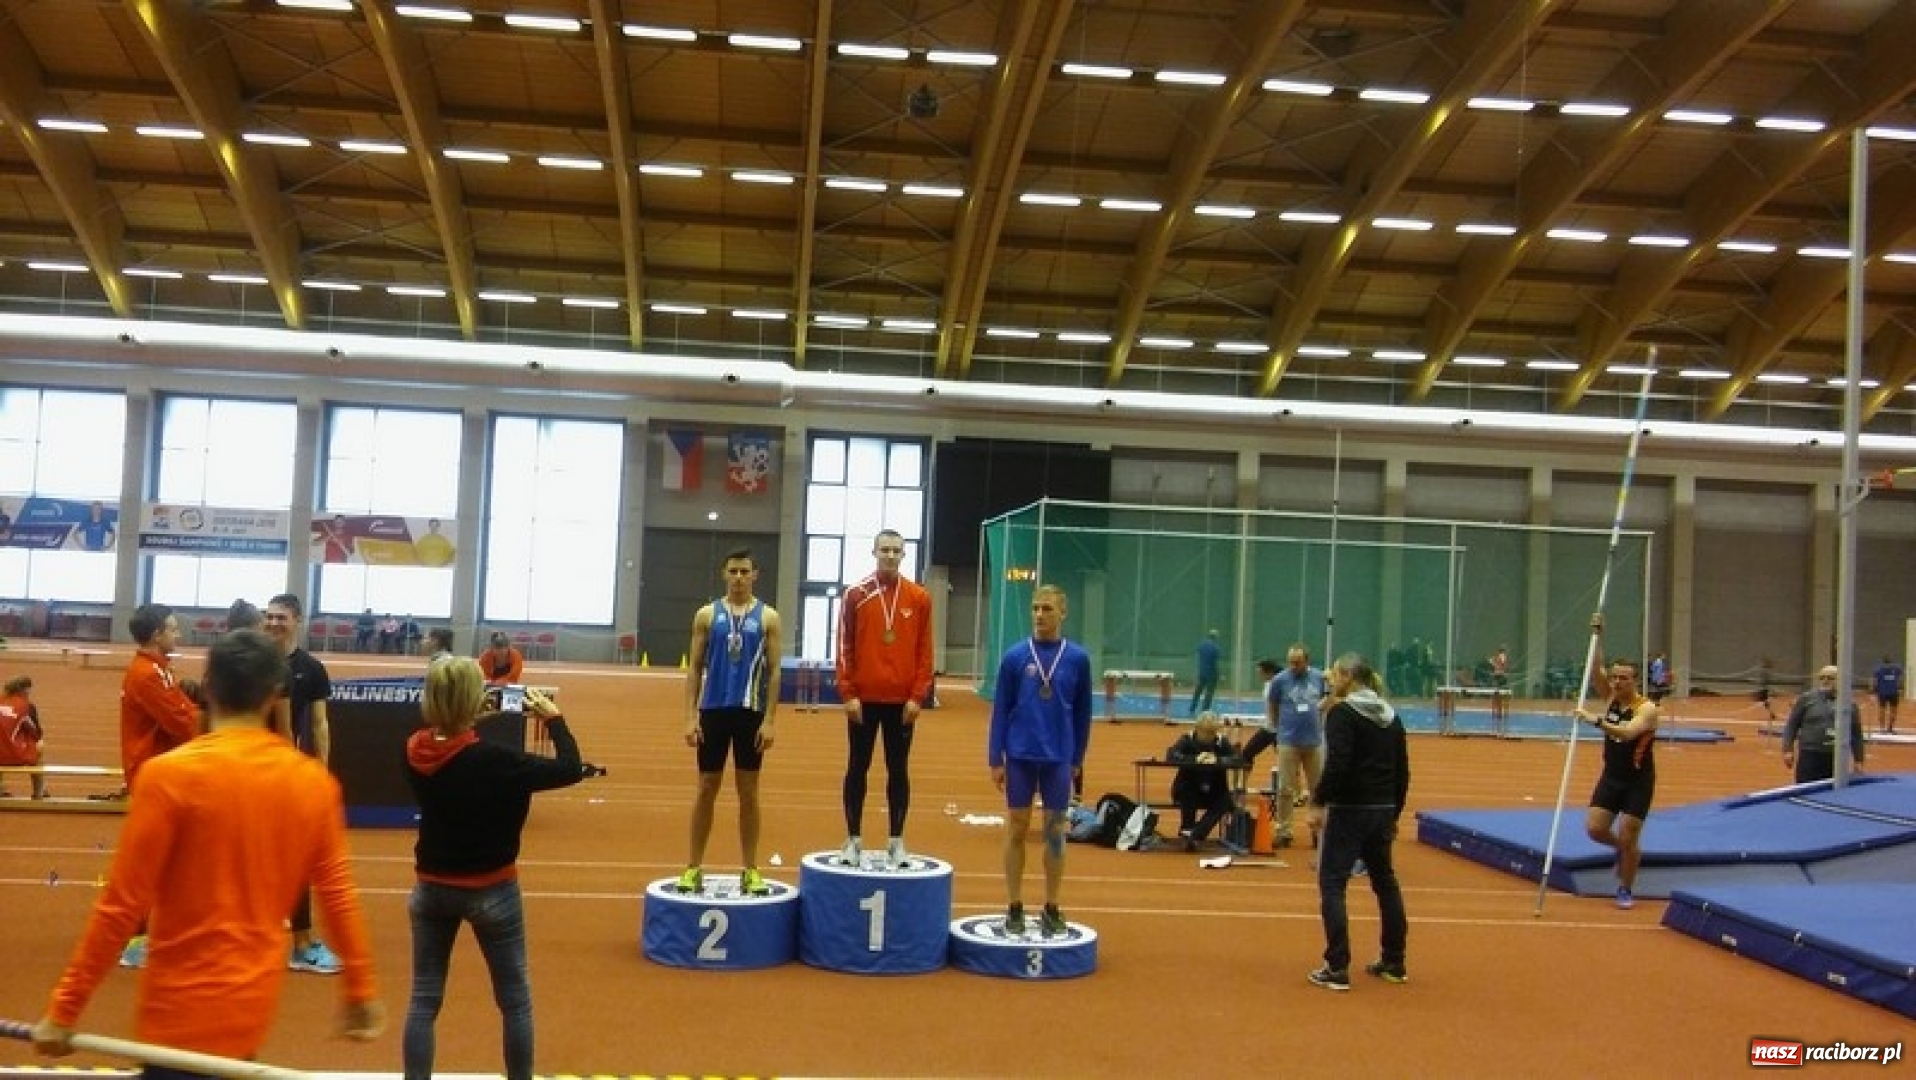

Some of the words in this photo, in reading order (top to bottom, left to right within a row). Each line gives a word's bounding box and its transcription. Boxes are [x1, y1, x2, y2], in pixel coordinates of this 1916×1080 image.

[696, 910, 729, 961] 2
[859, 890, 887, 952] 1
[1026, 950, 1044, 977] 3
